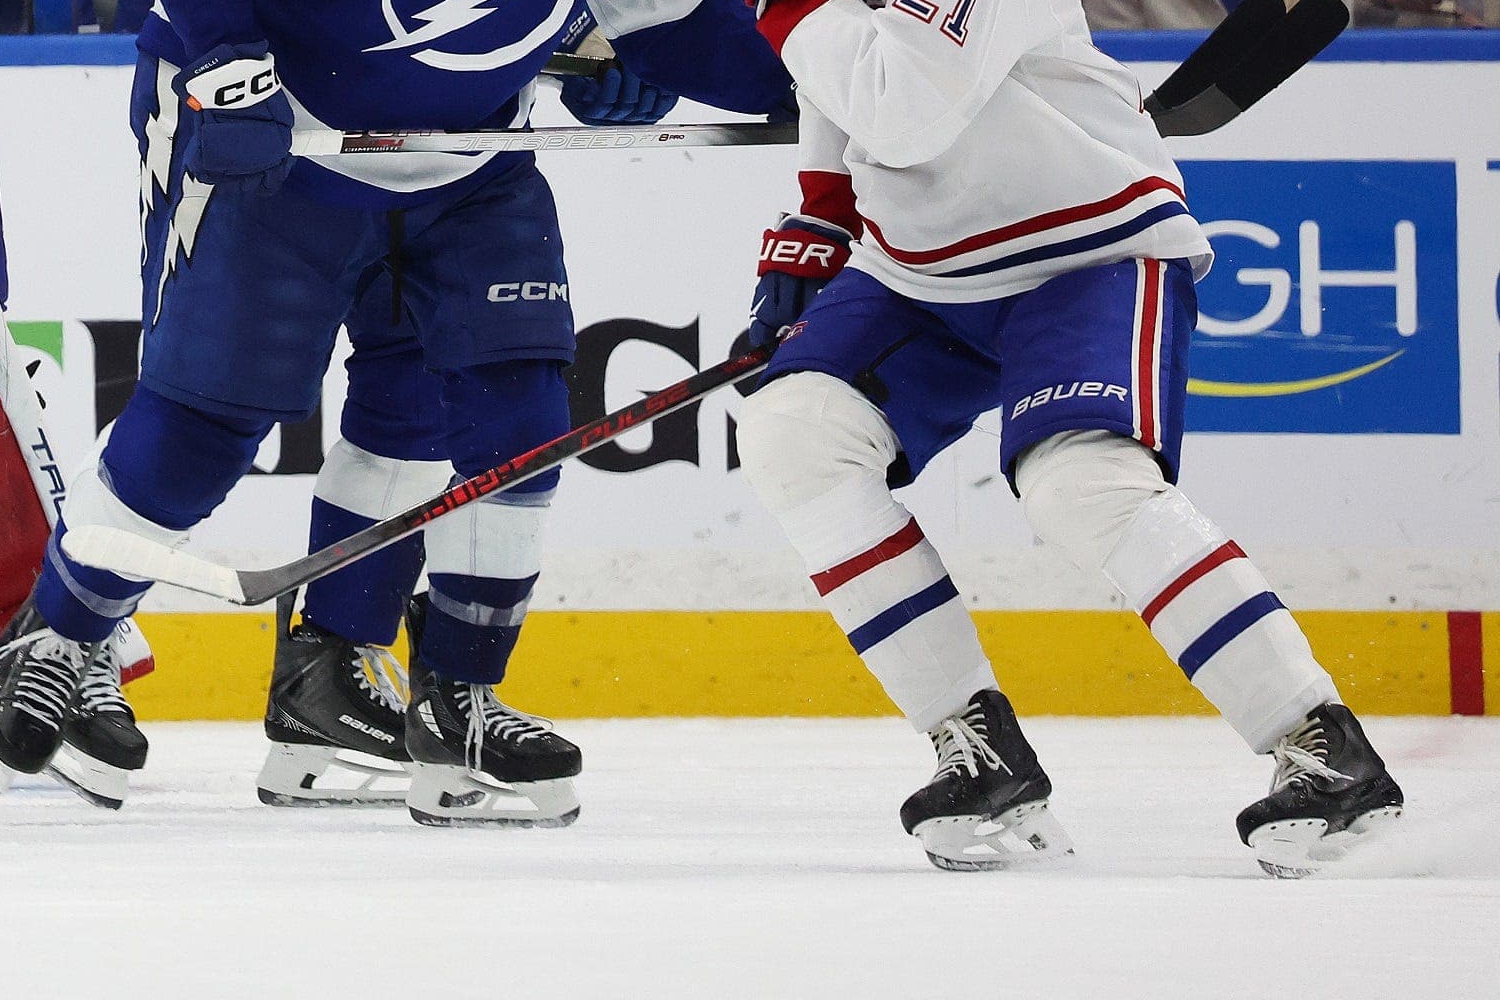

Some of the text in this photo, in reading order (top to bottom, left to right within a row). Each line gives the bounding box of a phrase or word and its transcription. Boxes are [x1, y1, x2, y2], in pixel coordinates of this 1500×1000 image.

[193, 57, 220, 75] CIRELLI
[213, 68, 280, 108] CC
[452, 133, 637, 151] JETSPEED
[486, 281, 568, 303] CCM
[1196, 219, 1419, 338] GH
[1010, 381, 1129, 421] BAUER
[338, 714, 396, 745] BAUER
